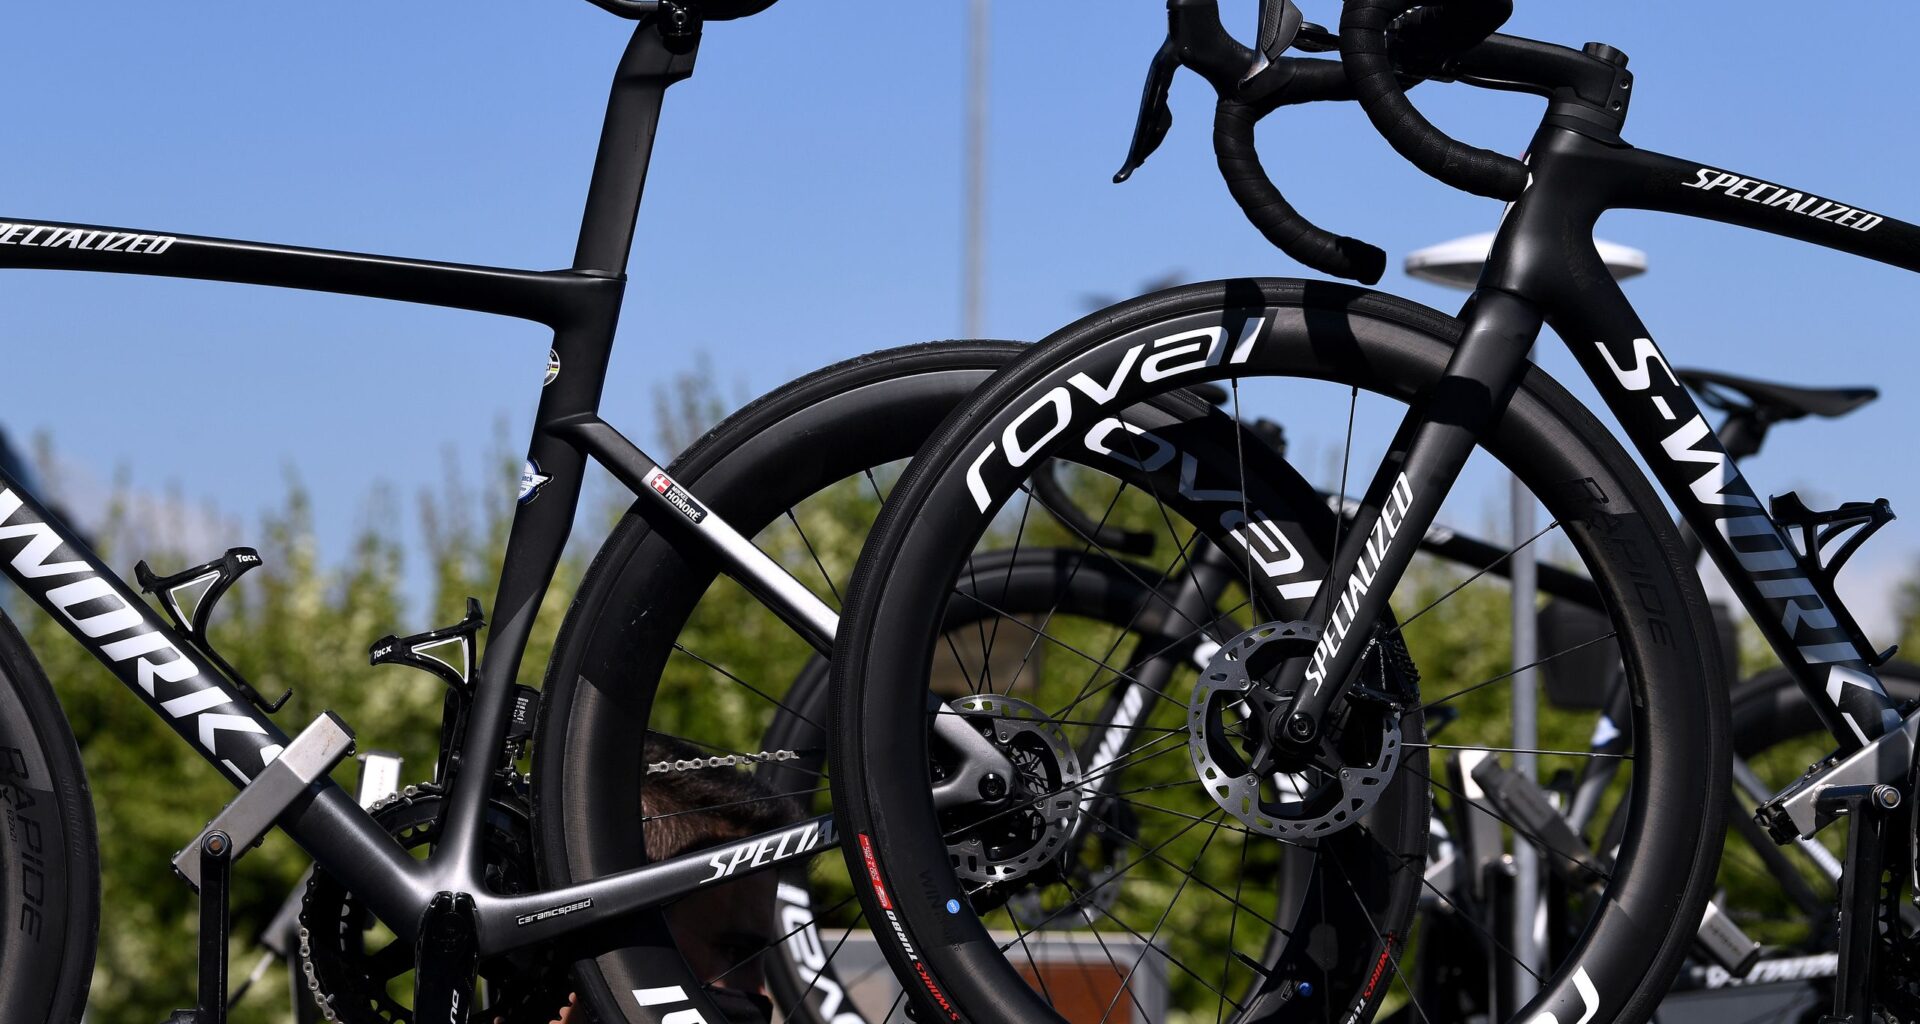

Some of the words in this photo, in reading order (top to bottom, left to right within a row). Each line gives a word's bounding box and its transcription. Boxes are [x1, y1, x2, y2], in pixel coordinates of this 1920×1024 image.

[1681, 168, 1884, 232] SPECIALIZED
[965, 317, 1266, 514] roval
[665, 490, 702, 522] HONORÉ
[1084, 417, 1323, 600] oval
[235, 553, 258, 563] Tacx
[1304, 471, 1414, 696] SPECIALIZED
[372, 643, 393, 659] Tacx
[699, 820, 839, 885] SPECIA
[517, 898, 591, 926] ceramicspeed
[885, 909, 919, 962] TURBO
[913, 961, 961, 1022] S-WORKS
